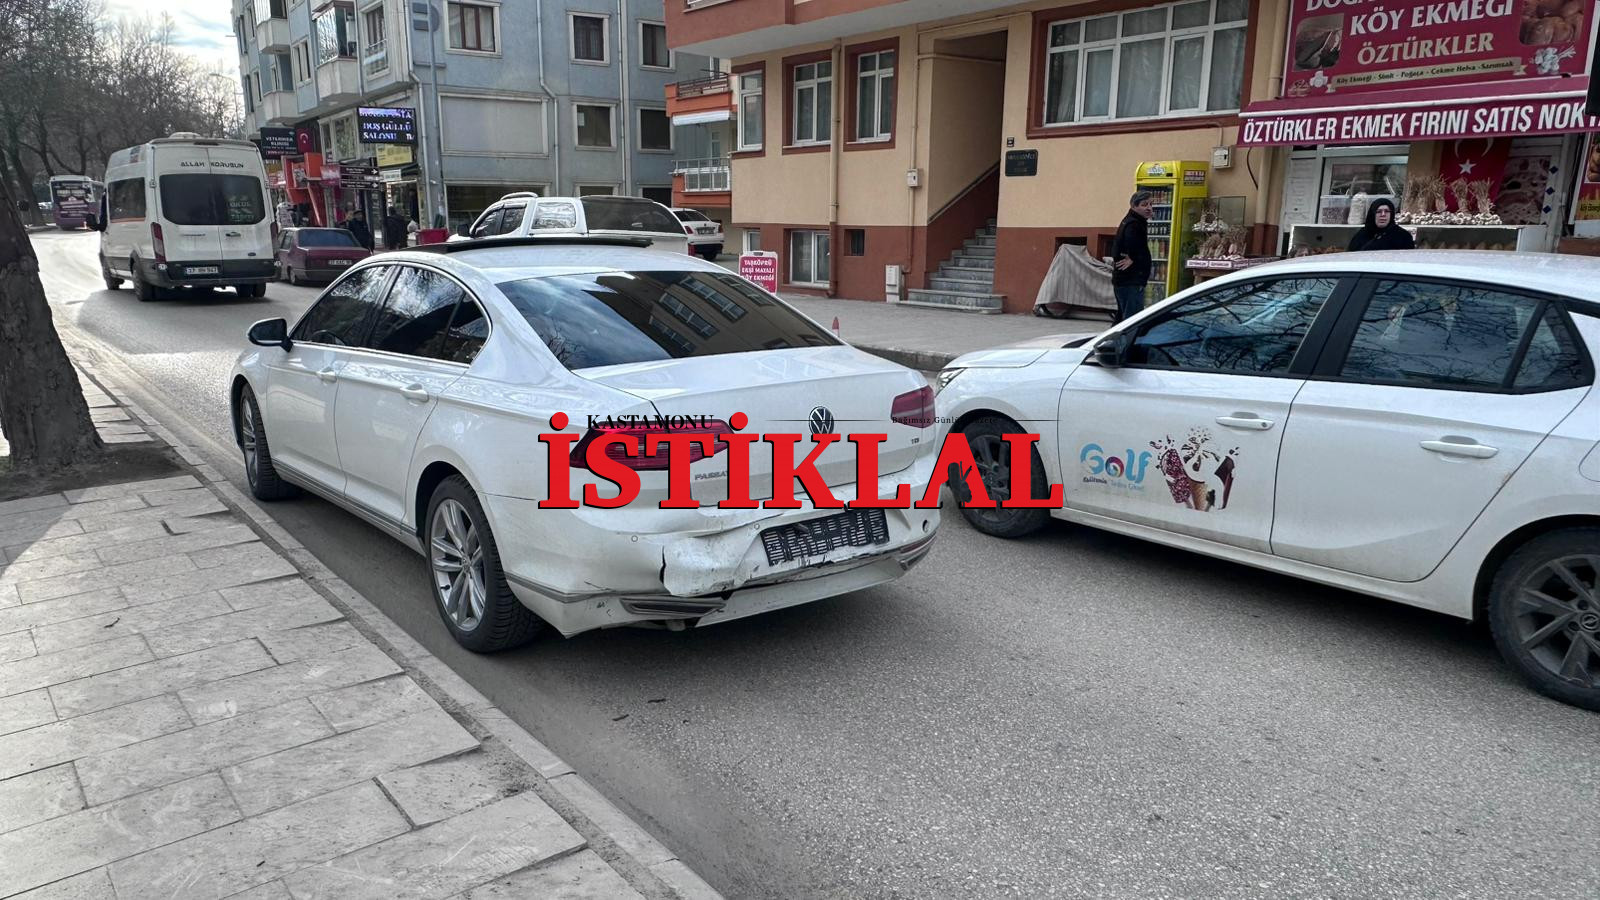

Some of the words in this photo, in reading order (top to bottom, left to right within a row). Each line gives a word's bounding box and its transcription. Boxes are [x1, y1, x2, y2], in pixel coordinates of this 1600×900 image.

[1350, 6, 1404, 36] KÖY
[1357, 32, 1494, 65] ÖZTÜRKLER
[1243, 116, 1337, 143] ÖZTÜRKLER
[1341, 113, 1406, 139] EKMEK
[1409, 109, 1469, 137] FIRINI
[1472, 105, 1534, 133] SATIŞ
[210, 161, 244, 169] KORUSUN
[1080, 443, 1152, 484] Golf
